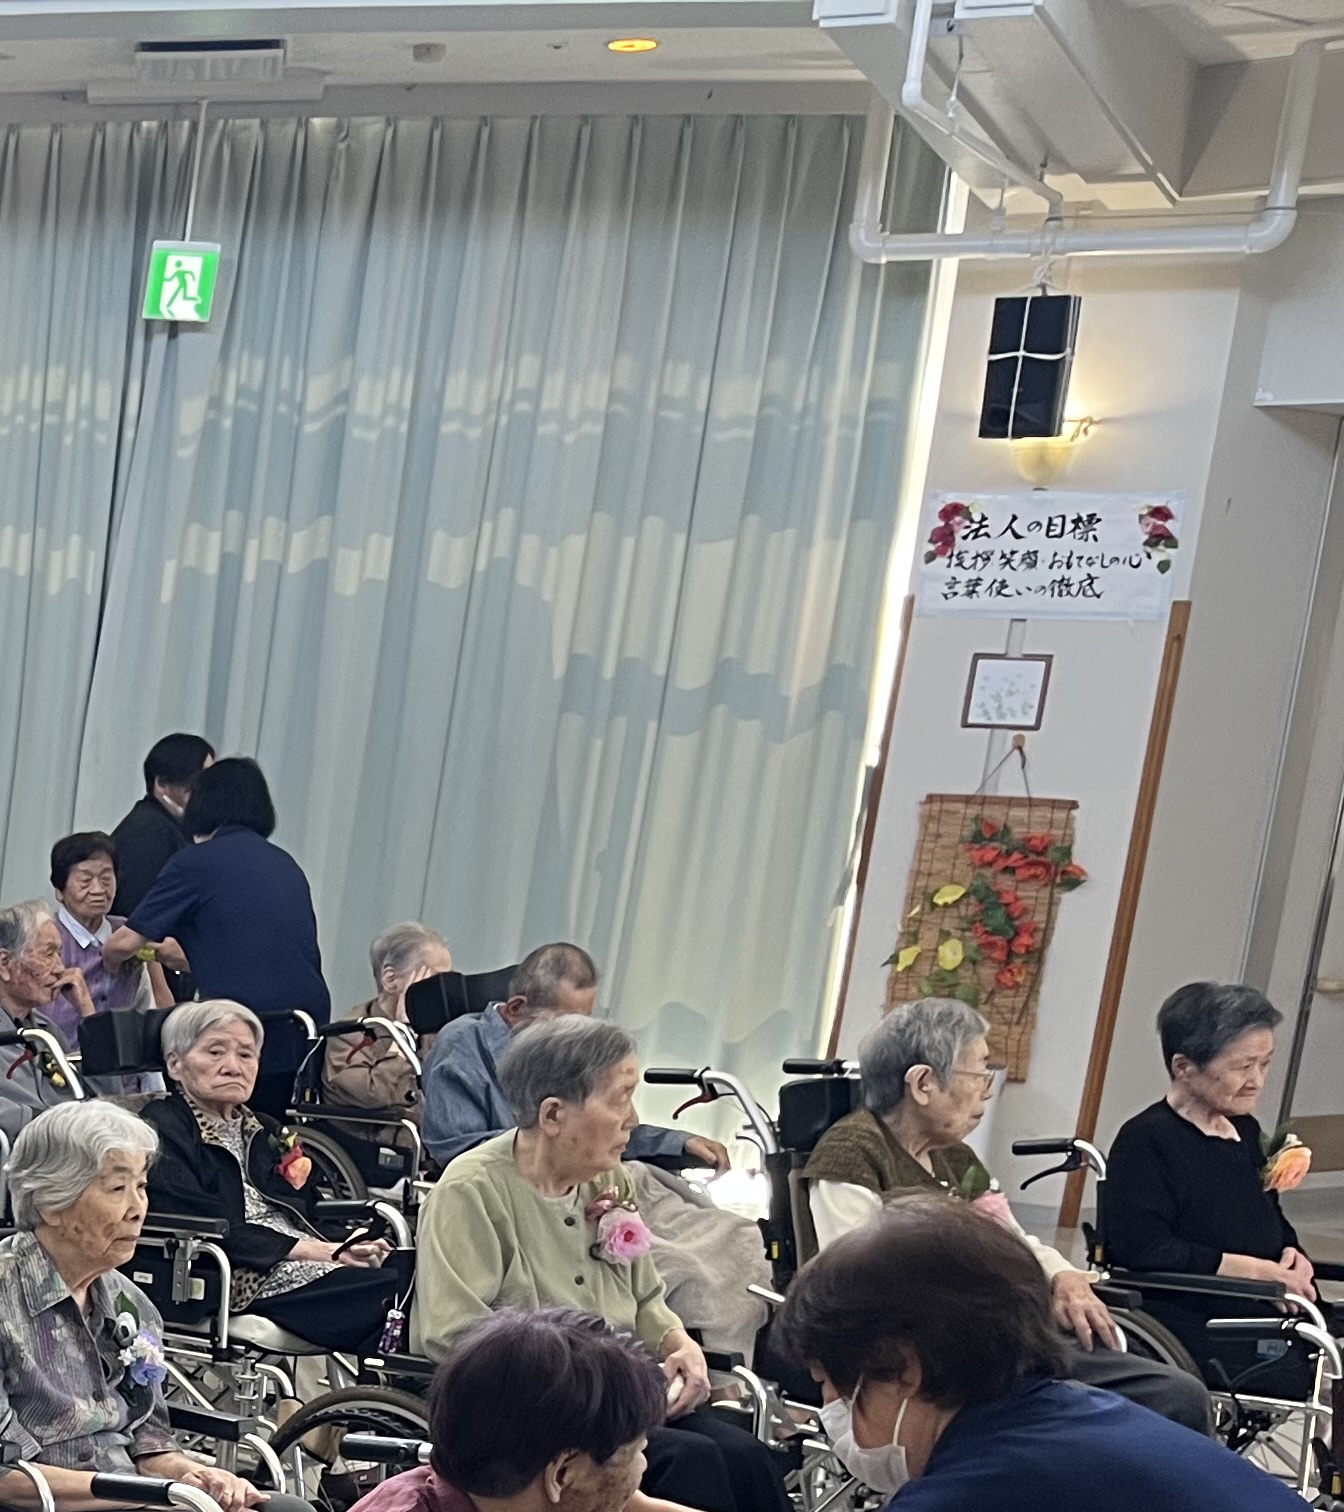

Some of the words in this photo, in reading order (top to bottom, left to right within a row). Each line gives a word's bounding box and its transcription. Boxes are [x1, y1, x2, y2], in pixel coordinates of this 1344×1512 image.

[961, 512, 1102, 543] 法人の目標
[941, 572, 1105, 600] 言葉使いの徹底
